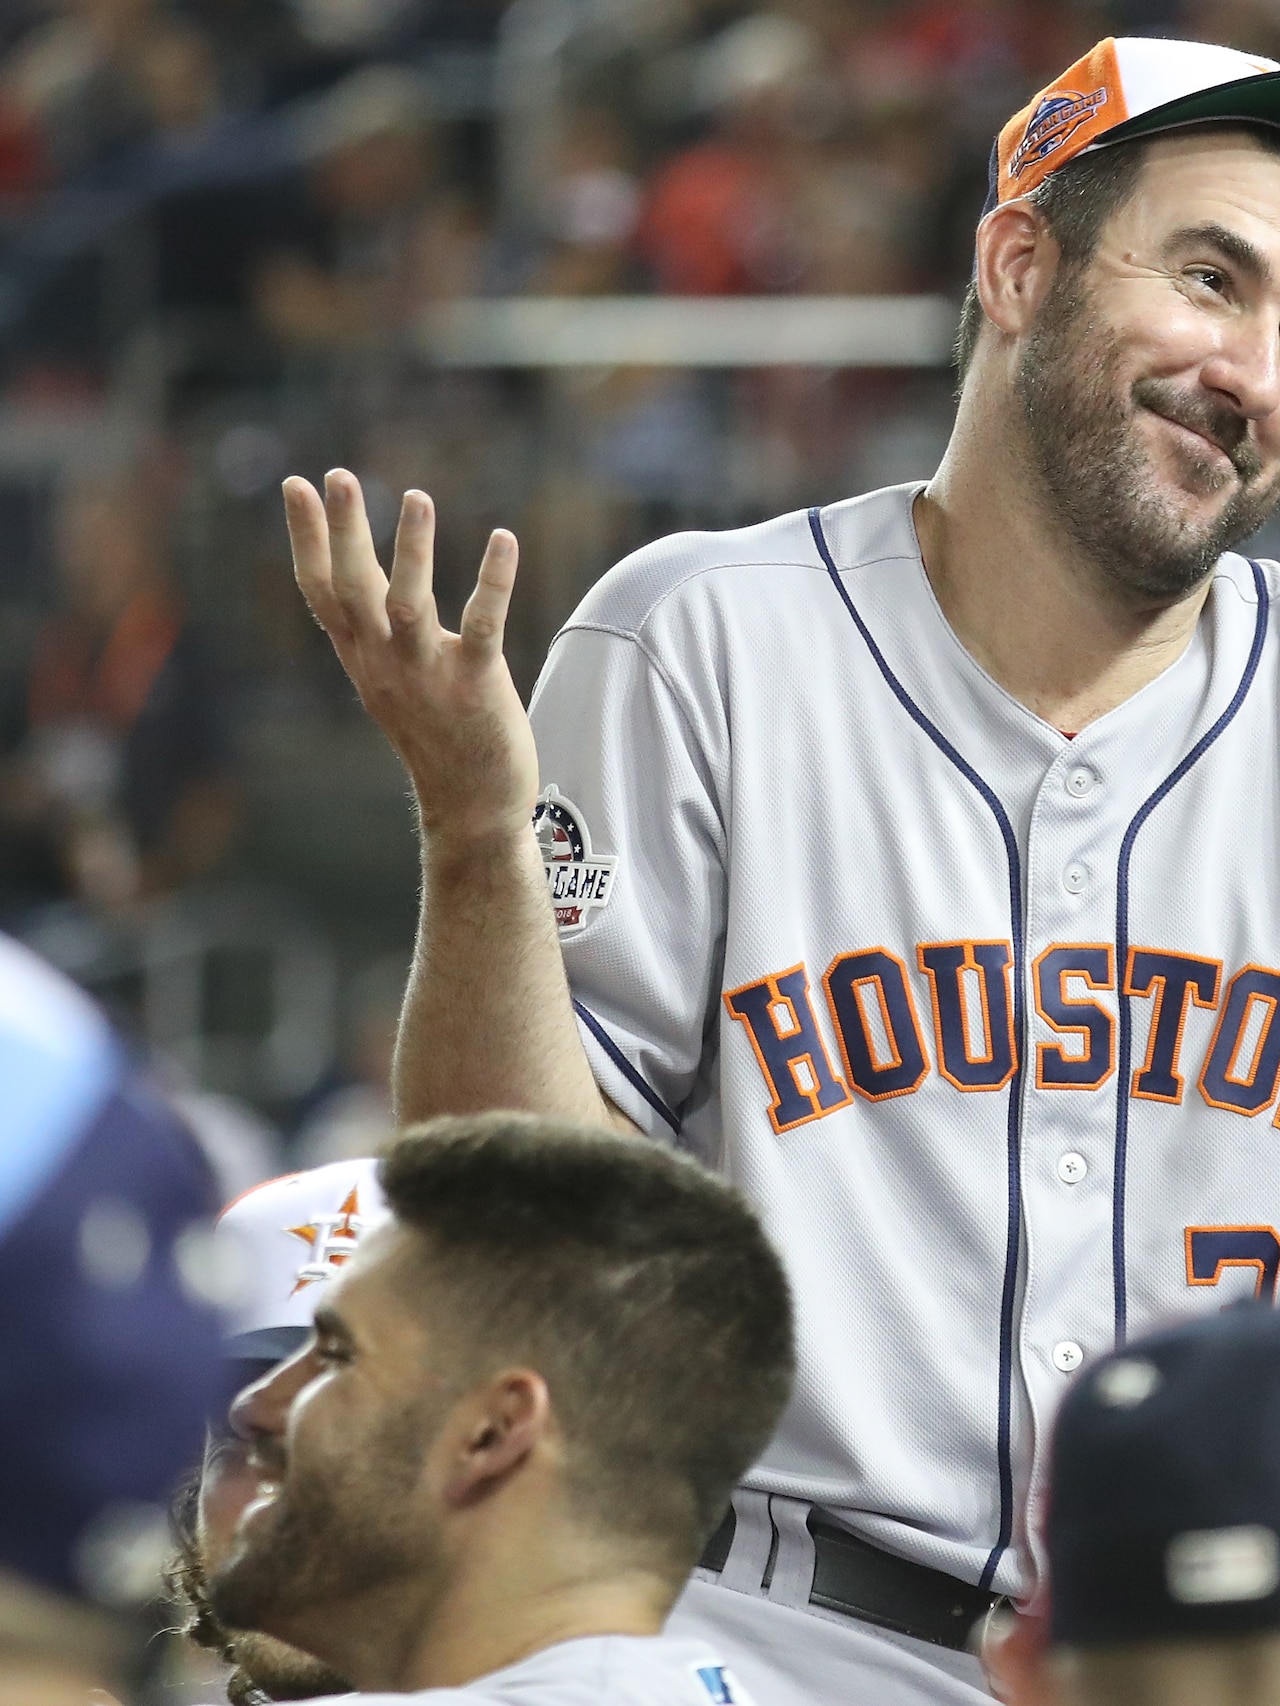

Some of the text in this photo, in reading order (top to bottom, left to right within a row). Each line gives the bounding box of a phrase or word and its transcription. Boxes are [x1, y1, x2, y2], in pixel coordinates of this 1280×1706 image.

[1062, 92, 1103, 121] GAME
[553, 866, 610, 899] GAME
[555, 909, 572, 919] 018
